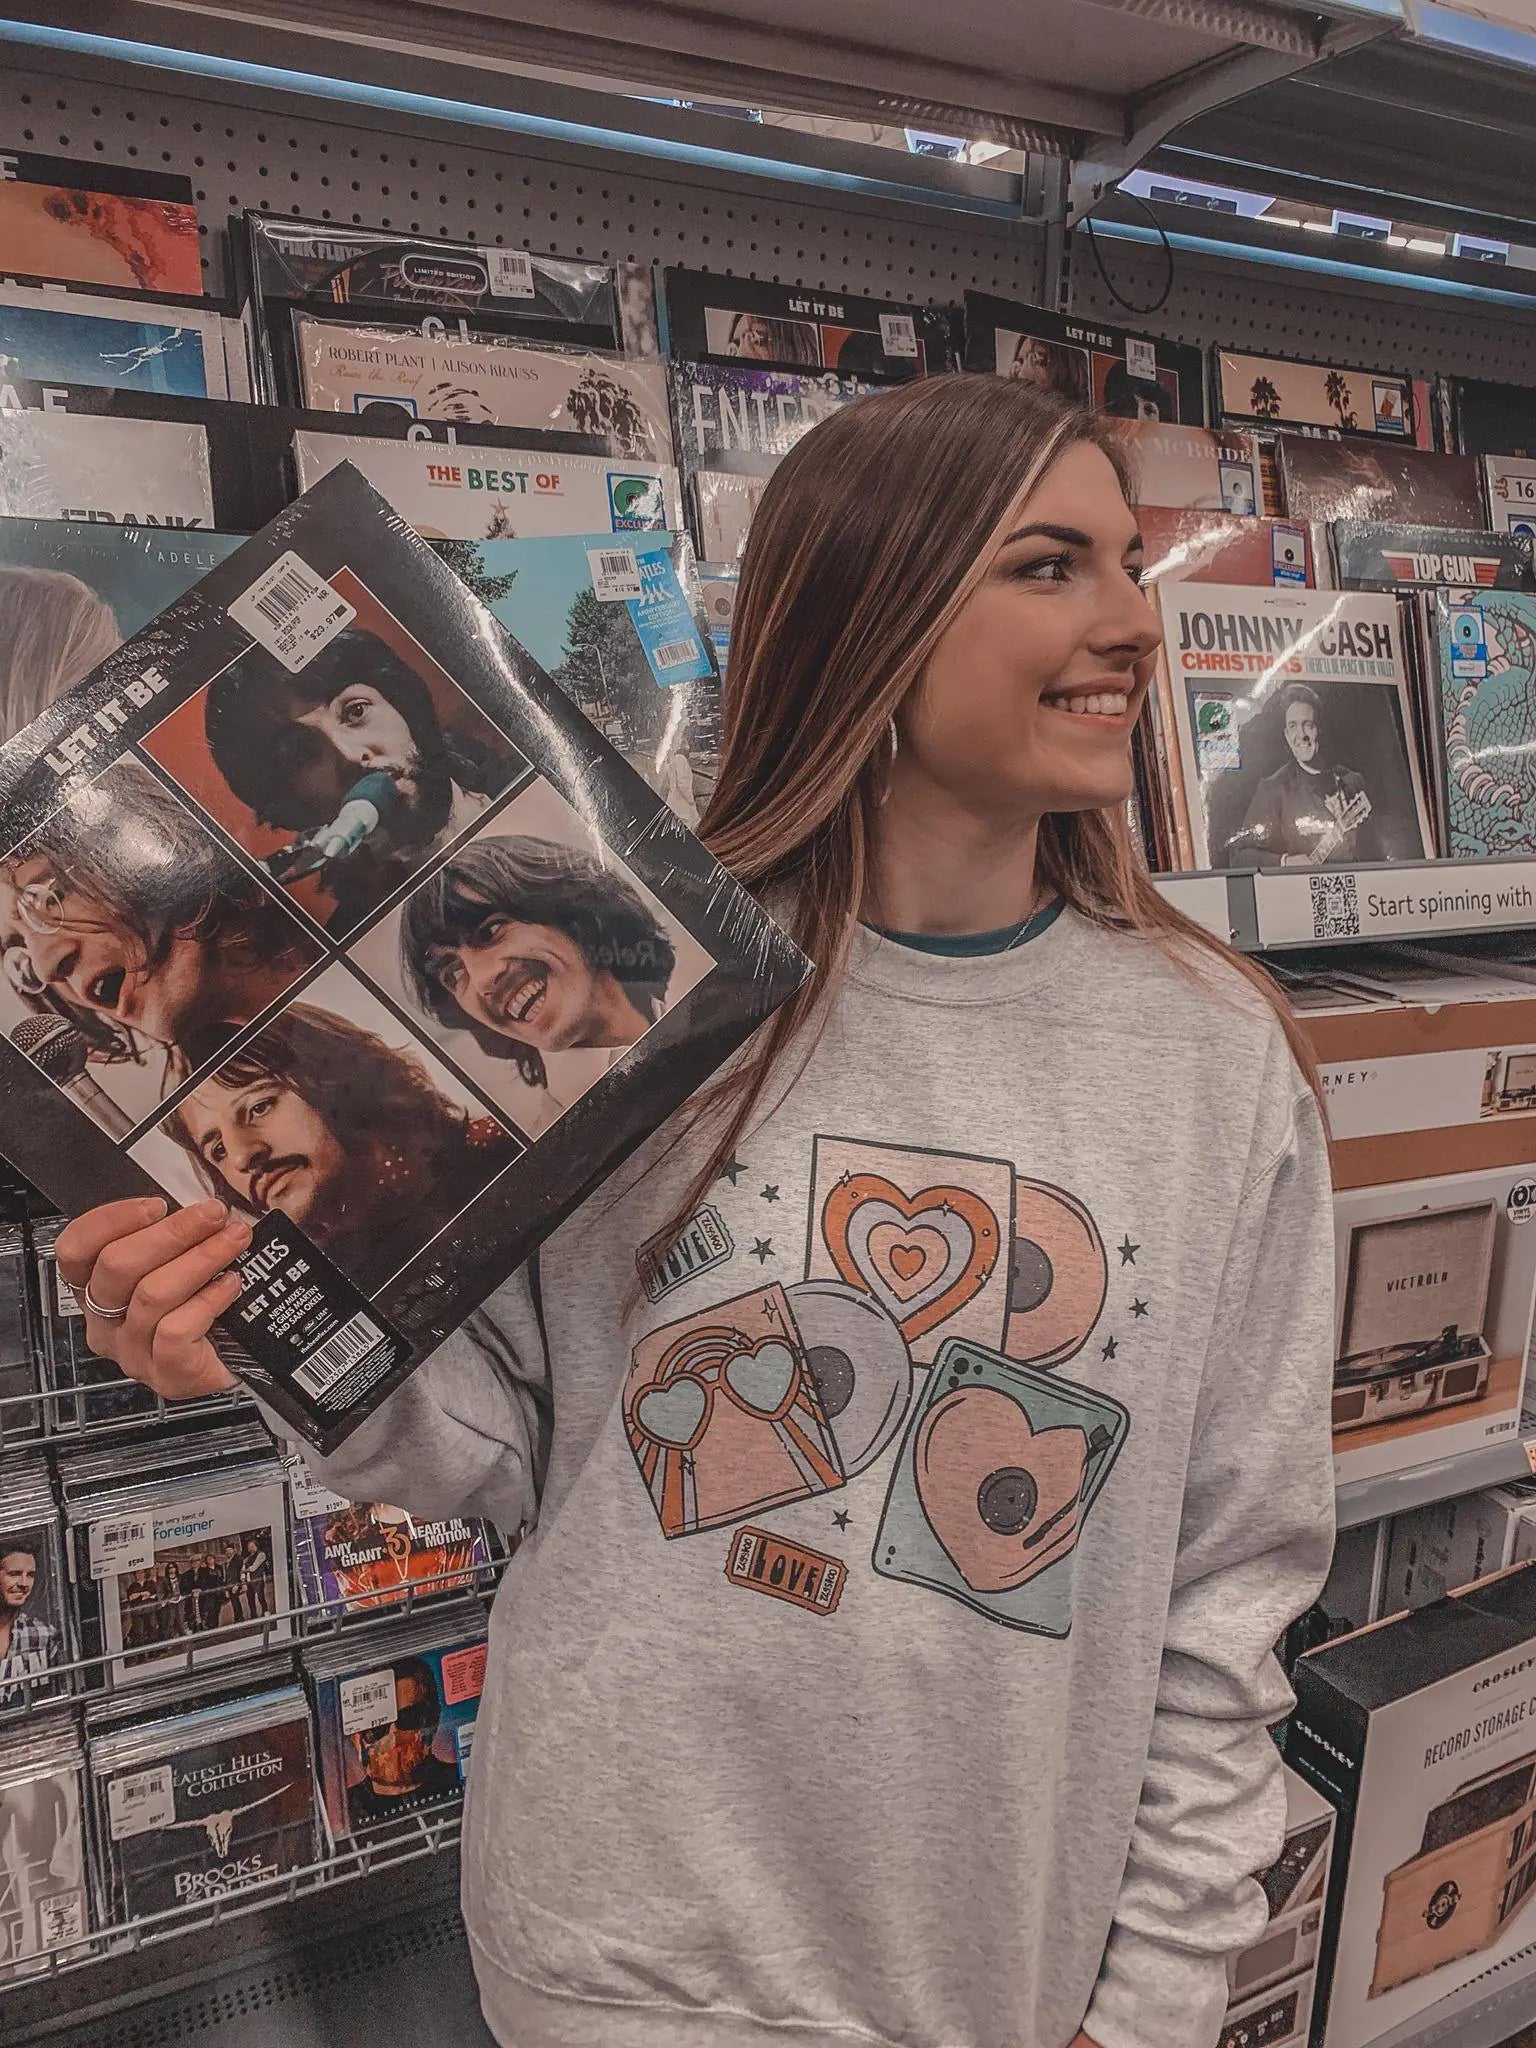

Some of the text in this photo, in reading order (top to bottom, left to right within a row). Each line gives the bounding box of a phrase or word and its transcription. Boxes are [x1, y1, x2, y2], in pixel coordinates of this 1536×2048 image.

[413, 267, 477, 281] LIMITED EDITION
[789, 300, 845, 319] LET IT BE
[1065, 326, 1113, 348] LET IT BE
[329, 346, 539, 382] ROBERT PLANT ALISON KRAUSS
[426, 464, 561, 494] THE BEST OF
[157, 551, 217, 566] ADELE
[1411, 553, 1477, 584] TOP GUN
[317, 589, 330, 602] NR
[309, 612, 338, 641] $23.97
[1178, 612, 1393, 660] JOHNNY CASH
[1181, 653, 1302, 673] CHRISTMAS
[43, 666, 170, 776] LET IT BE
[1367, 885, 1533, 919] Start spinning with
[1321, 1072, 1371, 1088] RNEY
[239, 1237, 291, 1292] EATLES
[240, 1258, 311, 1324] LET IT BE
[1386, 1271, 1449, 1292] VICTROLA
[267, 1285, 320, 1333] BY GILES MARTIN
[268, 1286, 306, 1320] NEW MIXES
[274, 1322, 291, 1339] AND
[288, 1309, 304, 1327] SAM
[300, 1292, 325, 1314] OKELL
[324, 1364, 348, 1387] 02507
[153, 1517, 165, 1528] the
[199, 1510, 207, 1519] of
[153, 1517, 215, 1541] foreigner
[446, 1518, 464, 1531] IN
[324, 1541, 353, 1560] AMY
[424, 1528, 471, 1548] MOTION
[341, 1549, 383, 1568] GRANT
[752, 1538, 821, 1600] LOVE
[1472, 1658, 1536, 1694] CROSLEY
[1295, 1719, 1356, 1770] CROSLEY
[1423, 1724, 1470, 1770] RECORD
[1473, 1705, 1526, 1749] STORAGE
[173, 1762, 226, 1789] EATEST
[231, 1750, 270, 1771] HITS
[187, 1761, 283, 1799] COLLECTION
[174, 1855, 262, 1898] BROOKS
